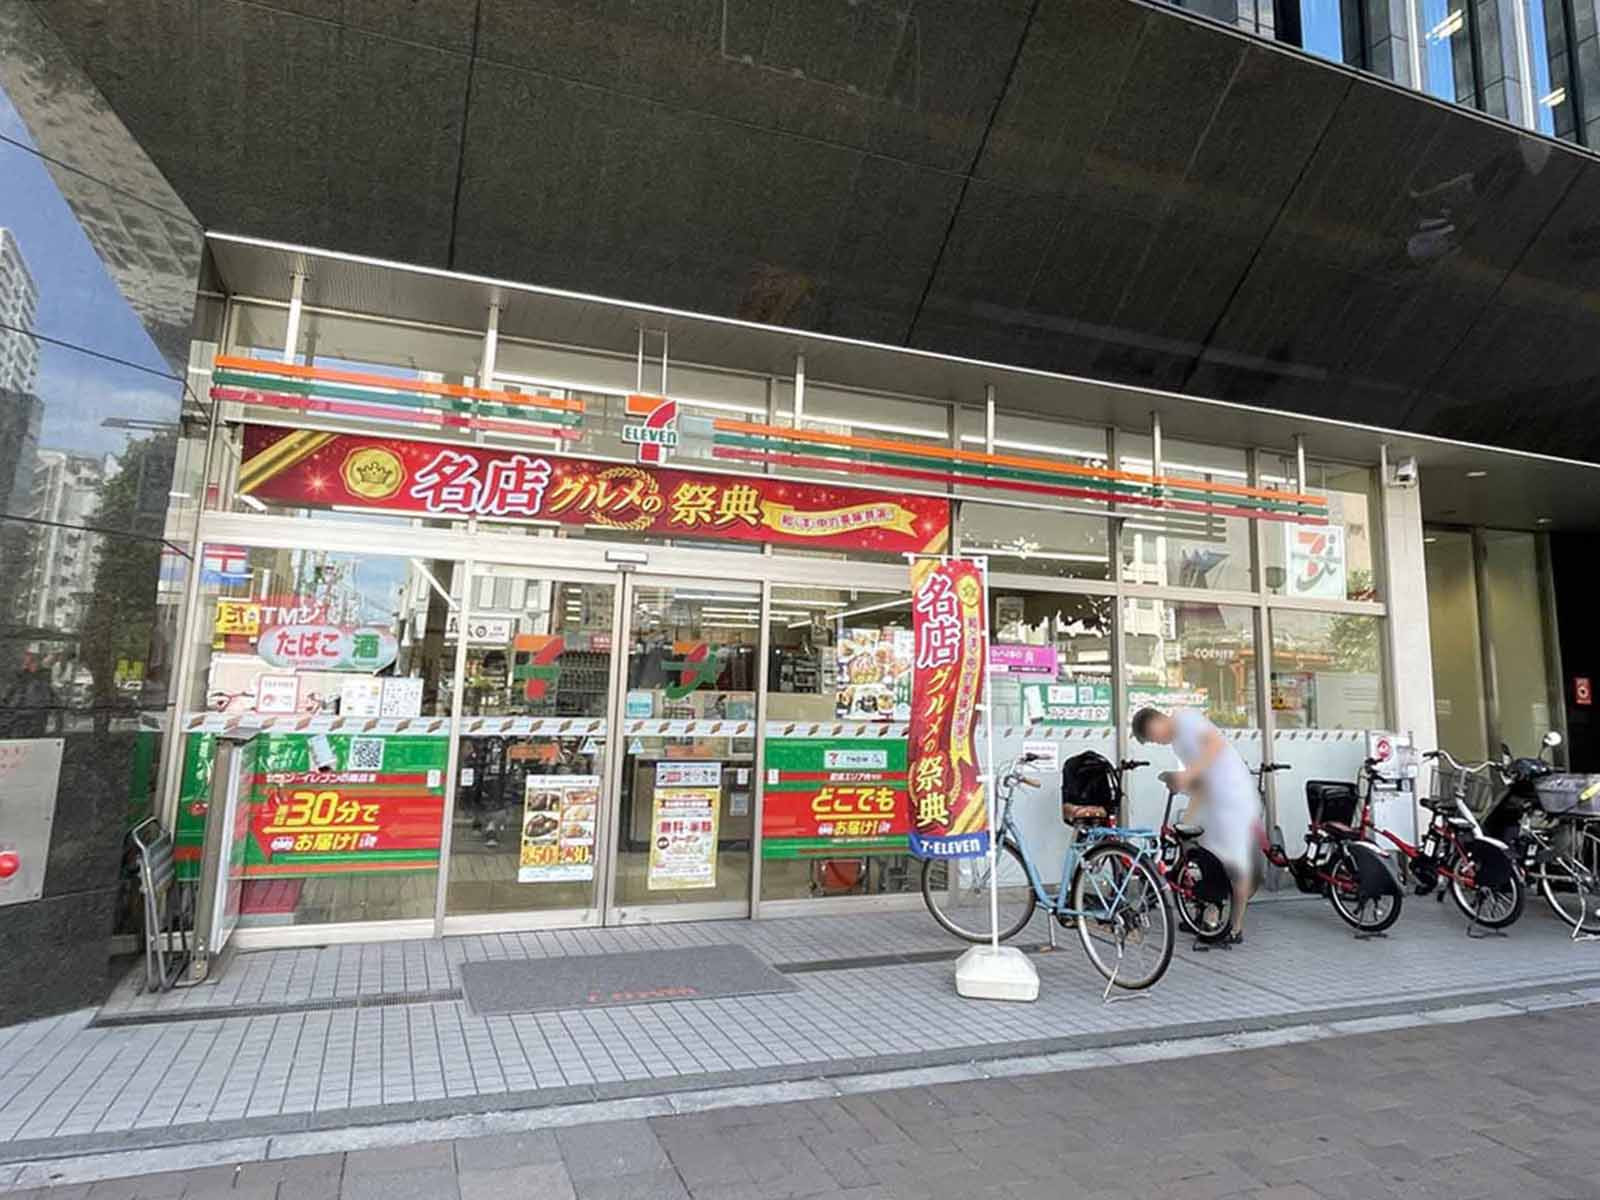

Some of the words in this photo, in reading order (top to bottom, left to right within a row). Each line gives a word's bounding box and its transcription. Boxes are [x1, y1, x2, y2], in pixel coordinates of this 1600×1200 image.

[275, 631, 339, 658] たばこ
[352, 634, 380, 659] 酒
[811, 787, 895, 813] どこでも
